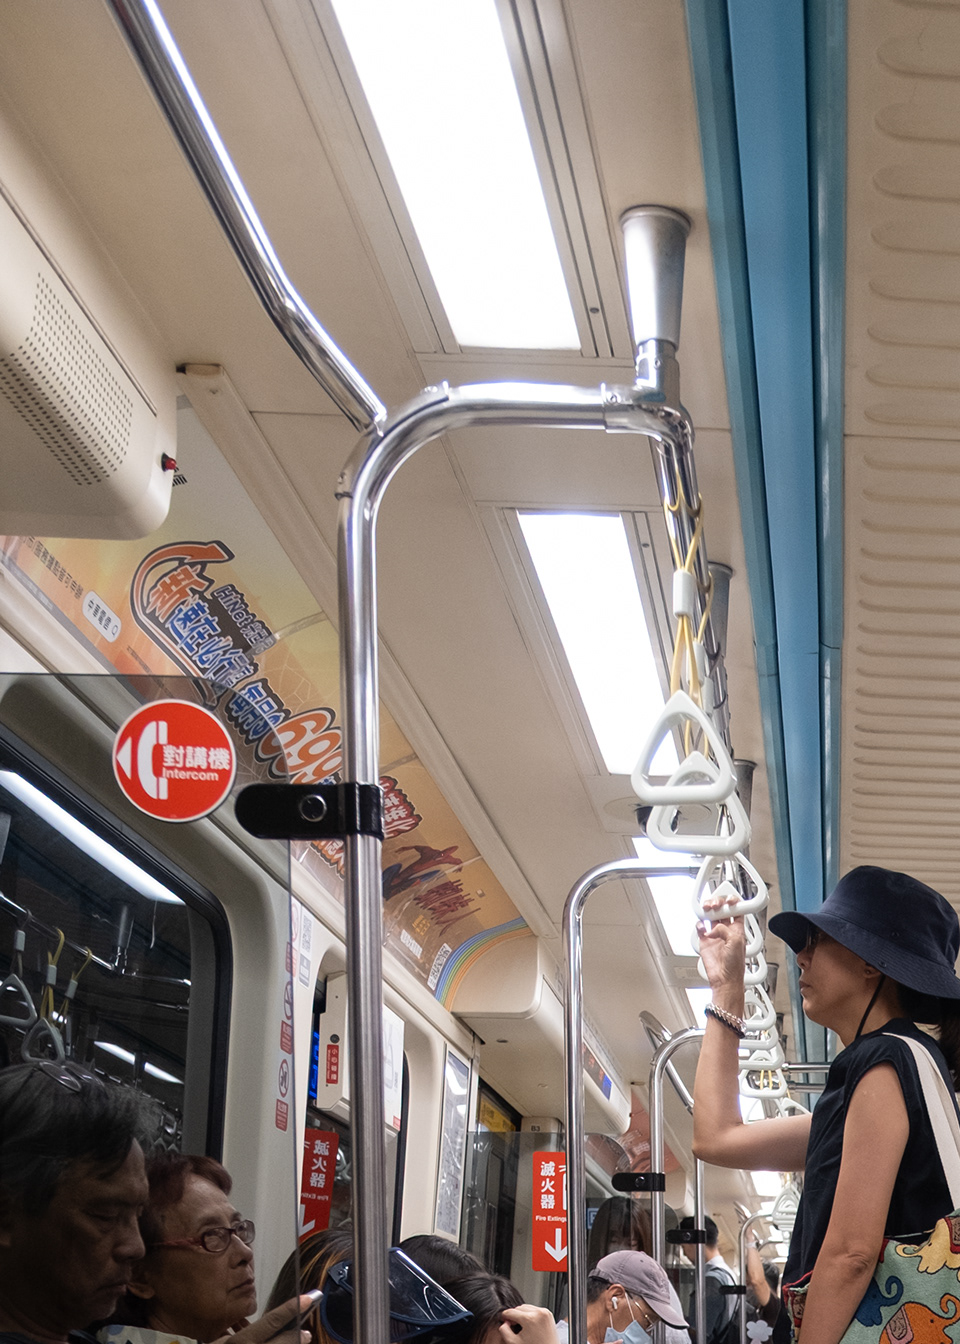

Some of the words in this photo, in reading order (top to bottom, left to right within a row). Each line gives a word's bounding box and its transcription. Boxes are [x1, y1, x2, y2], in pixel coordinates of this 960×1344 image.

[213, 585, 250, 632] HiNet
[162, 768, 219, 782] Intercom
[163, 745, 230, 770] 對講機
[540, 1161, 556, 1210] 滅火器
